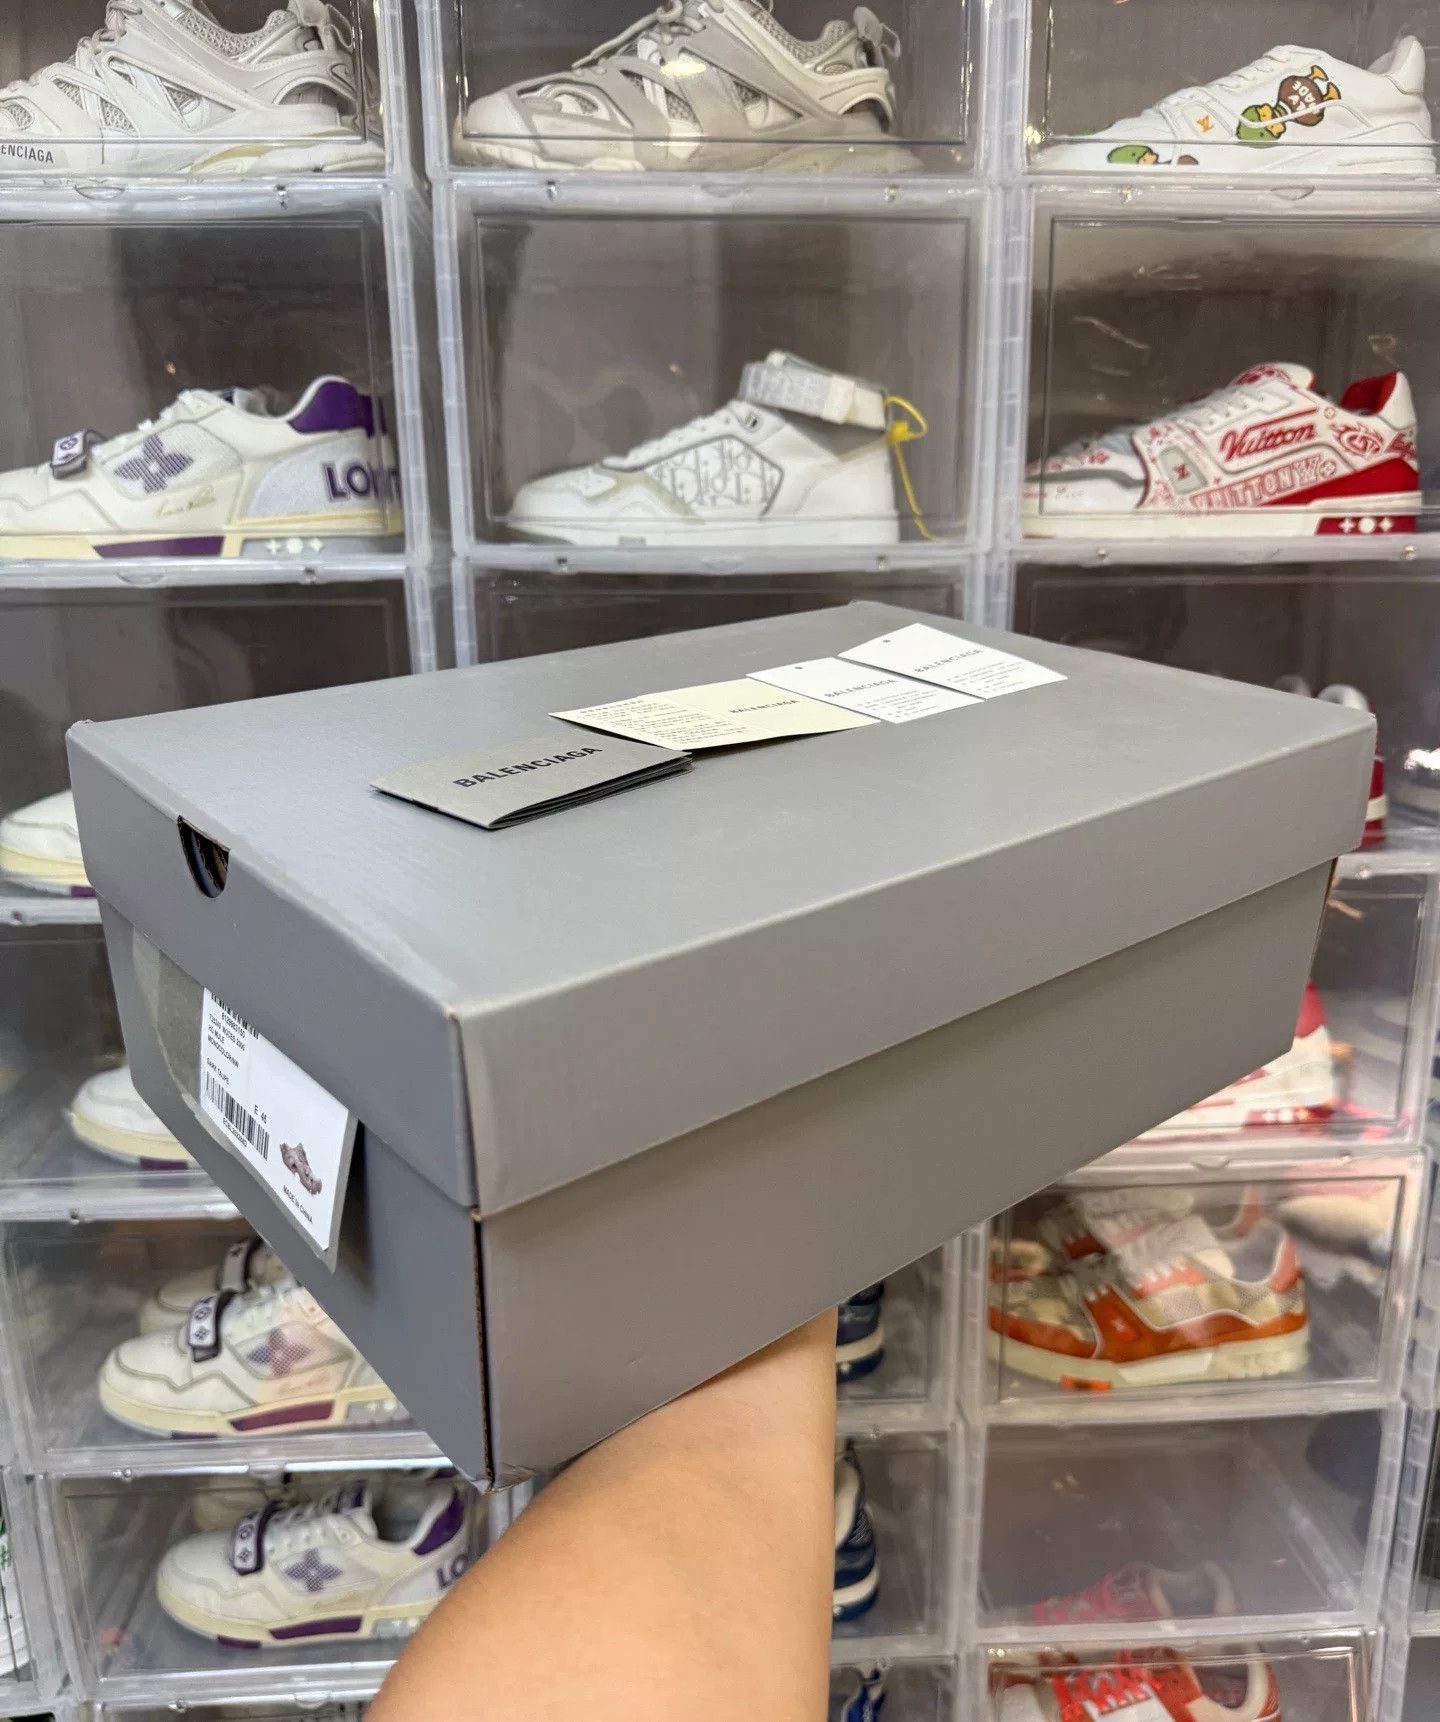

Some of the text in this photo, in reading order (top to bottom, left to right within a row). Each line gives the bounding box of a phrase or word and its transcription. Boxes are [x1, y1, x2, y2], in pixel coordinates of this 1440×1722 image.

[1, 144, 54, 164] ENCIAGA
[1218, 412, 1317, 462] Vuitton
[453, 746, 603, 788] BALENCIAGA
[254, 1104, 259, 1116] E
[283, 1184, 295, 1203] MADE
[299, 1204, 314, 1224] CHINA
